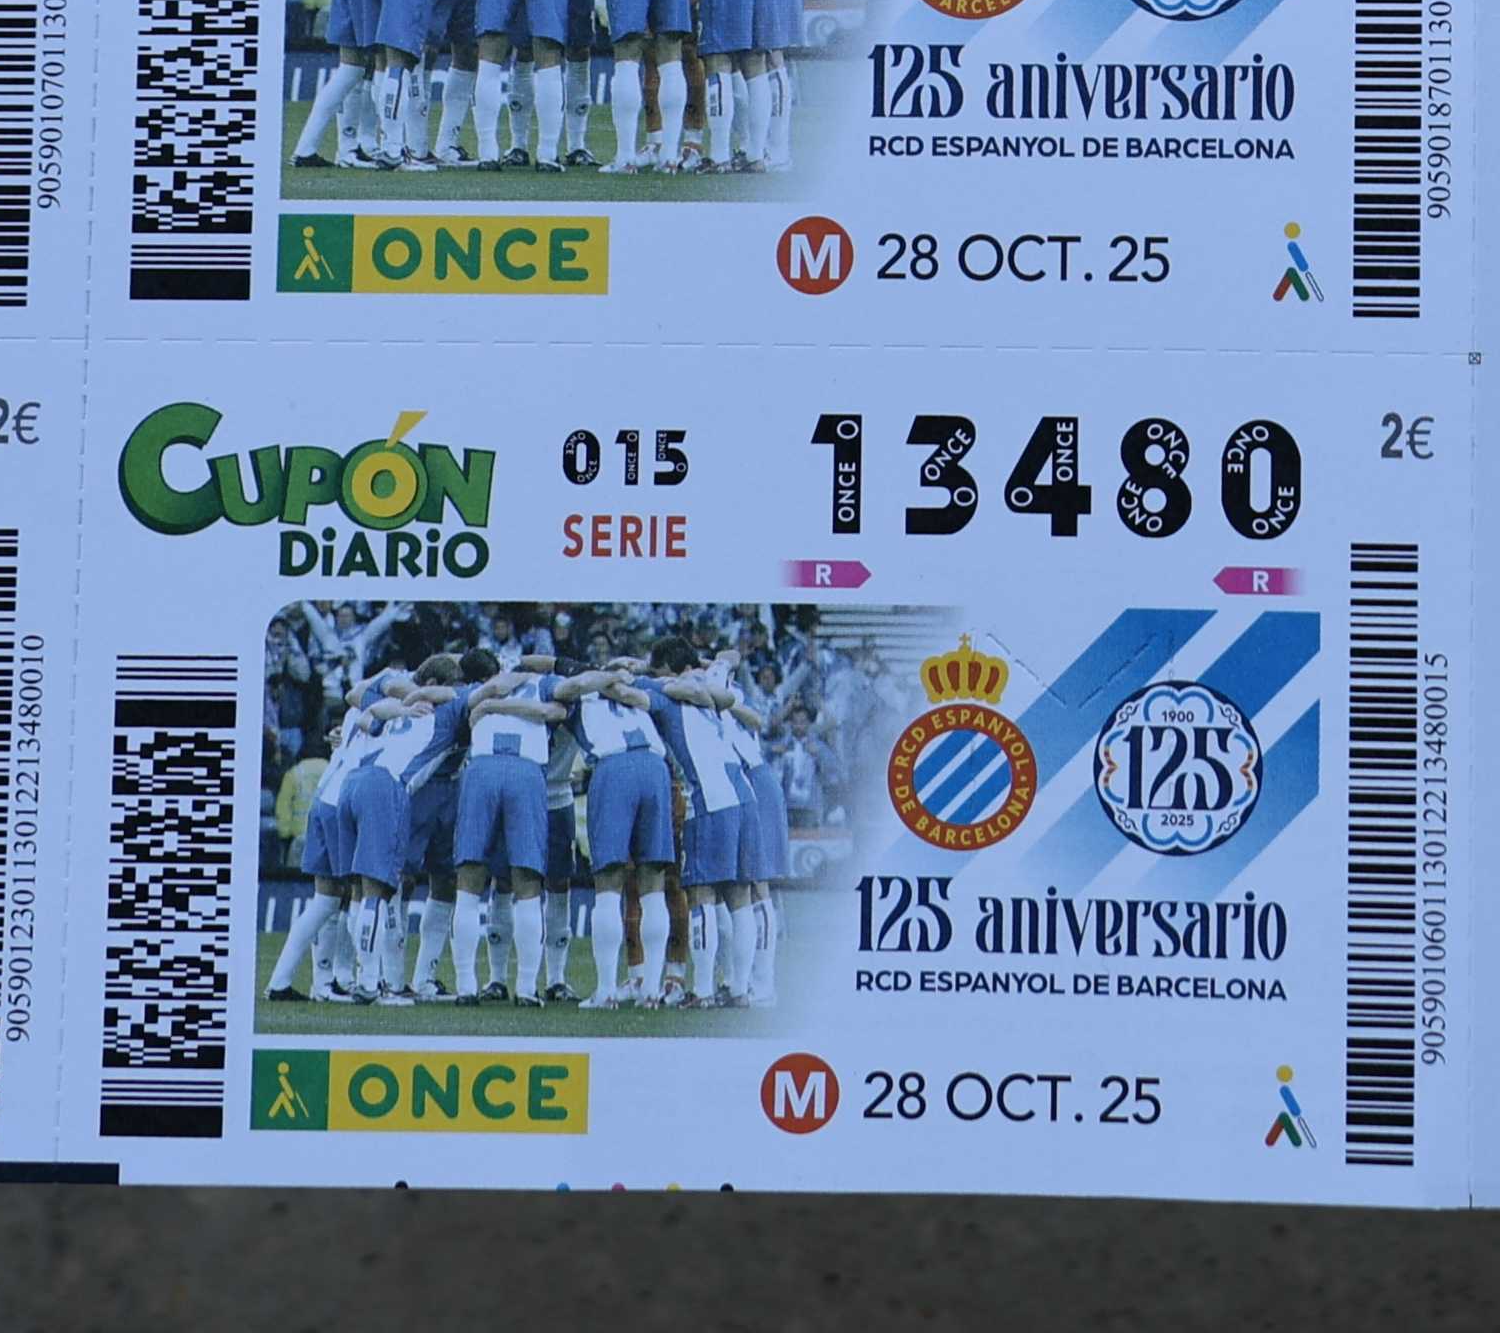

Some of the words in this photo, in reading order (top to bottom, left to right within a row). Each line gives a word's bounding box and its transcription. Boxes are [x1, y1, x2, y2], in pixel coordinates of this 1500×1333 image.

[867, 44, 965, 118] 125
[986, 52, 1295, 122] aniversario
[869, 135, 924, 157] RCD
[931, 136, 1075, 158] ESPANYOL
[1082, 137, 1119, 158] DE
[1126, 137, 1295, 160] BARCELONA
[370, 223, 593, 284] ONCE
[789, 233, 841, 280] M
[877, 233, 939, 281] 28
[958, 233, 1093, 282] OCT.
[1108, 235, 1170, 283] 25
[562, 429, 689, 486] 015
[1380, 412, 1434, 460] 2€
[810, 413, 1302, 540] 13480
[563, 513, 689, 559] SERIE
[6, 635, 44, 1042] 905901230113012213480010
[1422, 654, 1448, 1065] 905901060113012213480015
[855, 876, 953, 953] 125
[975, 886, 1287, 961] aniversario
[856, 970, 912, 992] RCD
[919, 971, 1066, 995] ESPANYOL
[1073, 974, 1110, 996] DE
[1117, 975, 1287, 1001] BARCELONA
[345, 1060, 571, 1123] ONCE
[773, 1070, 827, 1119] M
[863, 1071, 927, 1120] 28
[946, 1072, 1083, 1123] OCT.
[1099, 1075, 1161, 1125] 25
